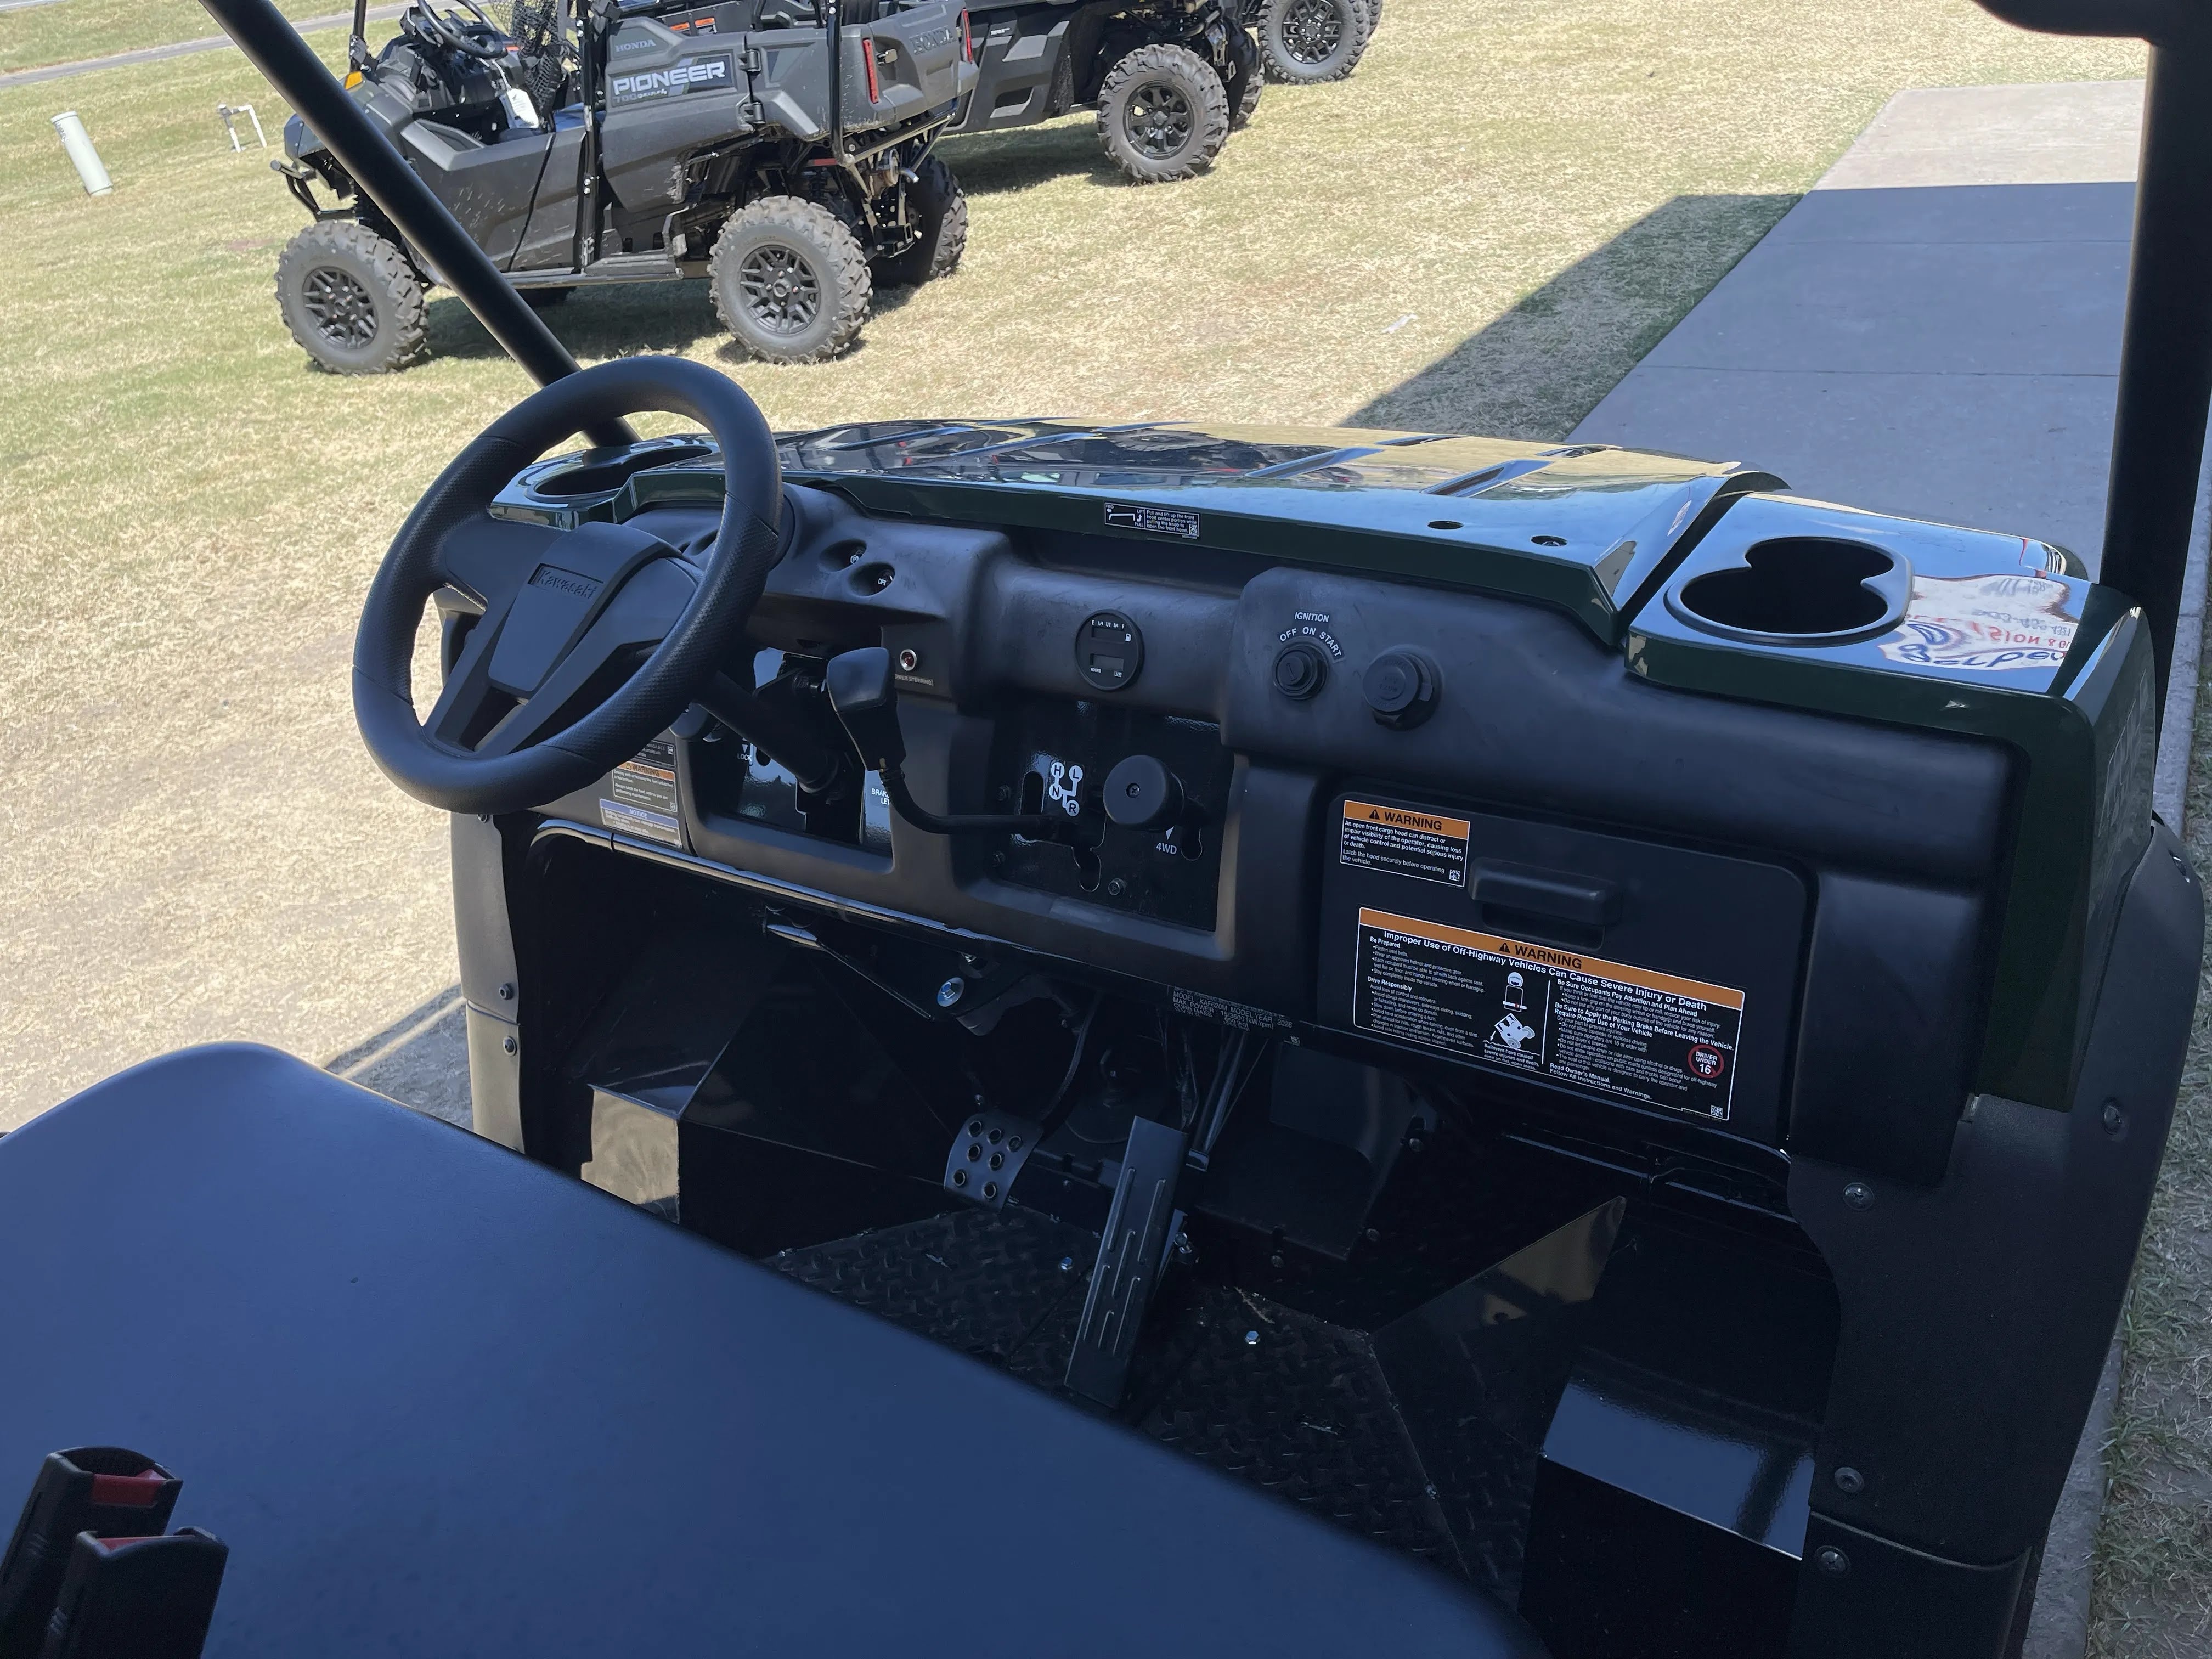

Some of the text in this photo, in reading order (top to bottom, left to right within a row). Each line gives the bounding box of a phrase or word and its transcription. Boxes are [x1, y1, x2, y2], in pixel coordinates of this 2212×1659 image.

[615, 40, 656, 52] HONDA
[612, 61, 725, 95] PIONEER
[537, 570, 597, 599] Kawasaki
[1294, 611, 1329, 623] IGNITION
[1279, 627, 1342, 658] OFF ON START
[908, 676, 932, 685] STEERING
[737, 753, 752, 762] LOCK
[633, 764, 659, 776] WARNING
[1054, 766, 1079, 779] H L
[1052, 787, 1060, 797] N
[629, 809, 648, 819] NOTICE
[1069, 804, 1076, 813] R
[1384, 811, 1442, 831] WARNING
[1362, 830, 1383, 839] visibility
[1401, 838, 1426, 847] operator,
[1427, 843, 1449, 852] causing
[1419, 834, 1438, 842] distract
[1156, 842, 1177, 855] 4WD
[1401, 844, 1425, 853] potential
[1448, 853, 1463, 861] injury
[1380, 856, 1402, 865] securely
[1402, 859, 1419, 867] before
[1420, 864, 1444, 874] operating
[1378, 938, 1400, 948] Prepared
[1514, 944, 1582, 969] WARNING
[1384, 930, 1421, 945] Improper
[1424, 939, 1440, 949] Use
[1453, 946, 1506, 966] Off-Highway
[1508, 958, 1546, 973] Vehicles
[1548, 967, 1566, 978] Can
[1569, 972, 1598, 985] Cause
[1600, 979, 1633, 993] Severe
[1635, 987, 1663, 1001] Injury
[1678, 997, 1708, 1011] Death
[1367, 975, 1412, 992] Drive Responsibly
[1566, 980, 1579, 989] Sure
[1580, 984, 1610, 996] Occupants
[1611, 991, 1622, 1001] Pay
[1623, 994, 1650, 1006] Attention
[1651, 1002, 1663, 1010] and
[1663, 1003, 1677, 1012] Plan
[1678, 1007, 1697, 1017] Ahead
[1173, 1003, 1193, 1013] CURB
[1173, 991, 1293, 1028] MODEL KAF620M MODEL YEAR 2026
[1190, 1002, 1215, 1013] POWER
[1221, 1011, 1245, 1022] 15/3600
[1554, 1008, 1576, 1018] Require
[1577, 1013, 1596, 1023] Proper
[1597, 1018, 1608, 1026] Use
[1616, 1023, 1630, 1031] Your
[1631, 1026, 1652, 1037] Vehicle
[1564, 1004, 1577, 1012] Sure
[1584, 1009, 1601, 1020] Apply
[1612, 1015, 1634, 1028] Parking
[1635, 1021, 1652, 1031] Brake
[1654, 1025, 1673, 1036] Before
[1674, 1031, 1698, 1043] Leaving
[1710, 1039, 1734, 1051] Vehicle.
[1484, 1043, 1504, 1052] Rollovers
[1696, 1051, 1717, 1060] DRIVER
[1696, 1056, 1716, 1065] UNDER
[1565, 1066, 1588, 1077] Owner's
[1589, 1073, 1610, 1083] Manual.
[1699, 1063, 1711, 1074] 16
[1550, 1068, 1568, 1077] Follow
[1577, 1075, 1610, 1088] Instructions
[1623, 1087, 1652, 1099] Warnings.
